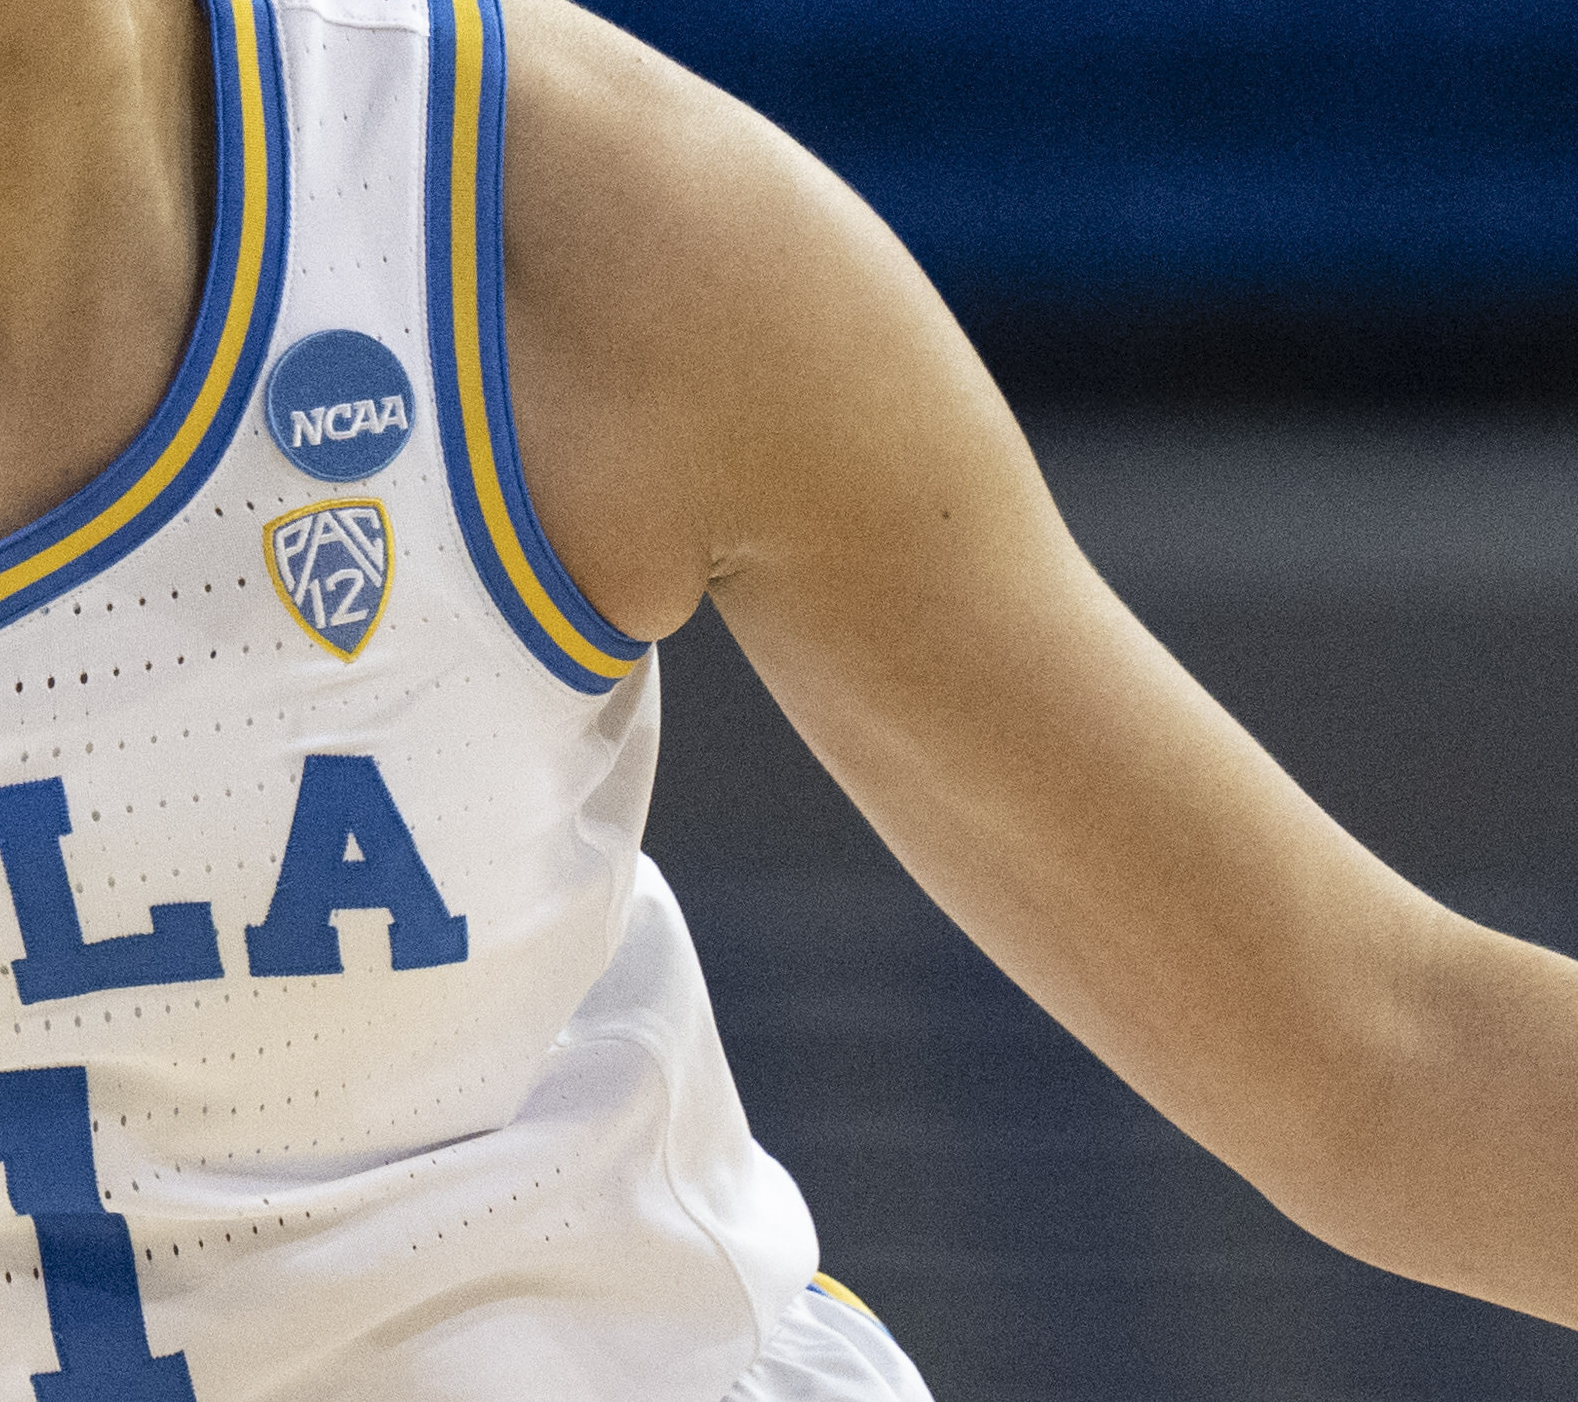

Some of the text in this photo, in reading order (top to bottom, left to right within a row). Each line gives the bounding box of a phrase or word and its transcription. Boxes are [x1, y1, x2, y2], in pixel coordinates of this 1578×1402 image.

[291, 395, 408, 447] NCAA
[274, 508, 385, 606] PAC
[308, 568, 370, 630] 12
